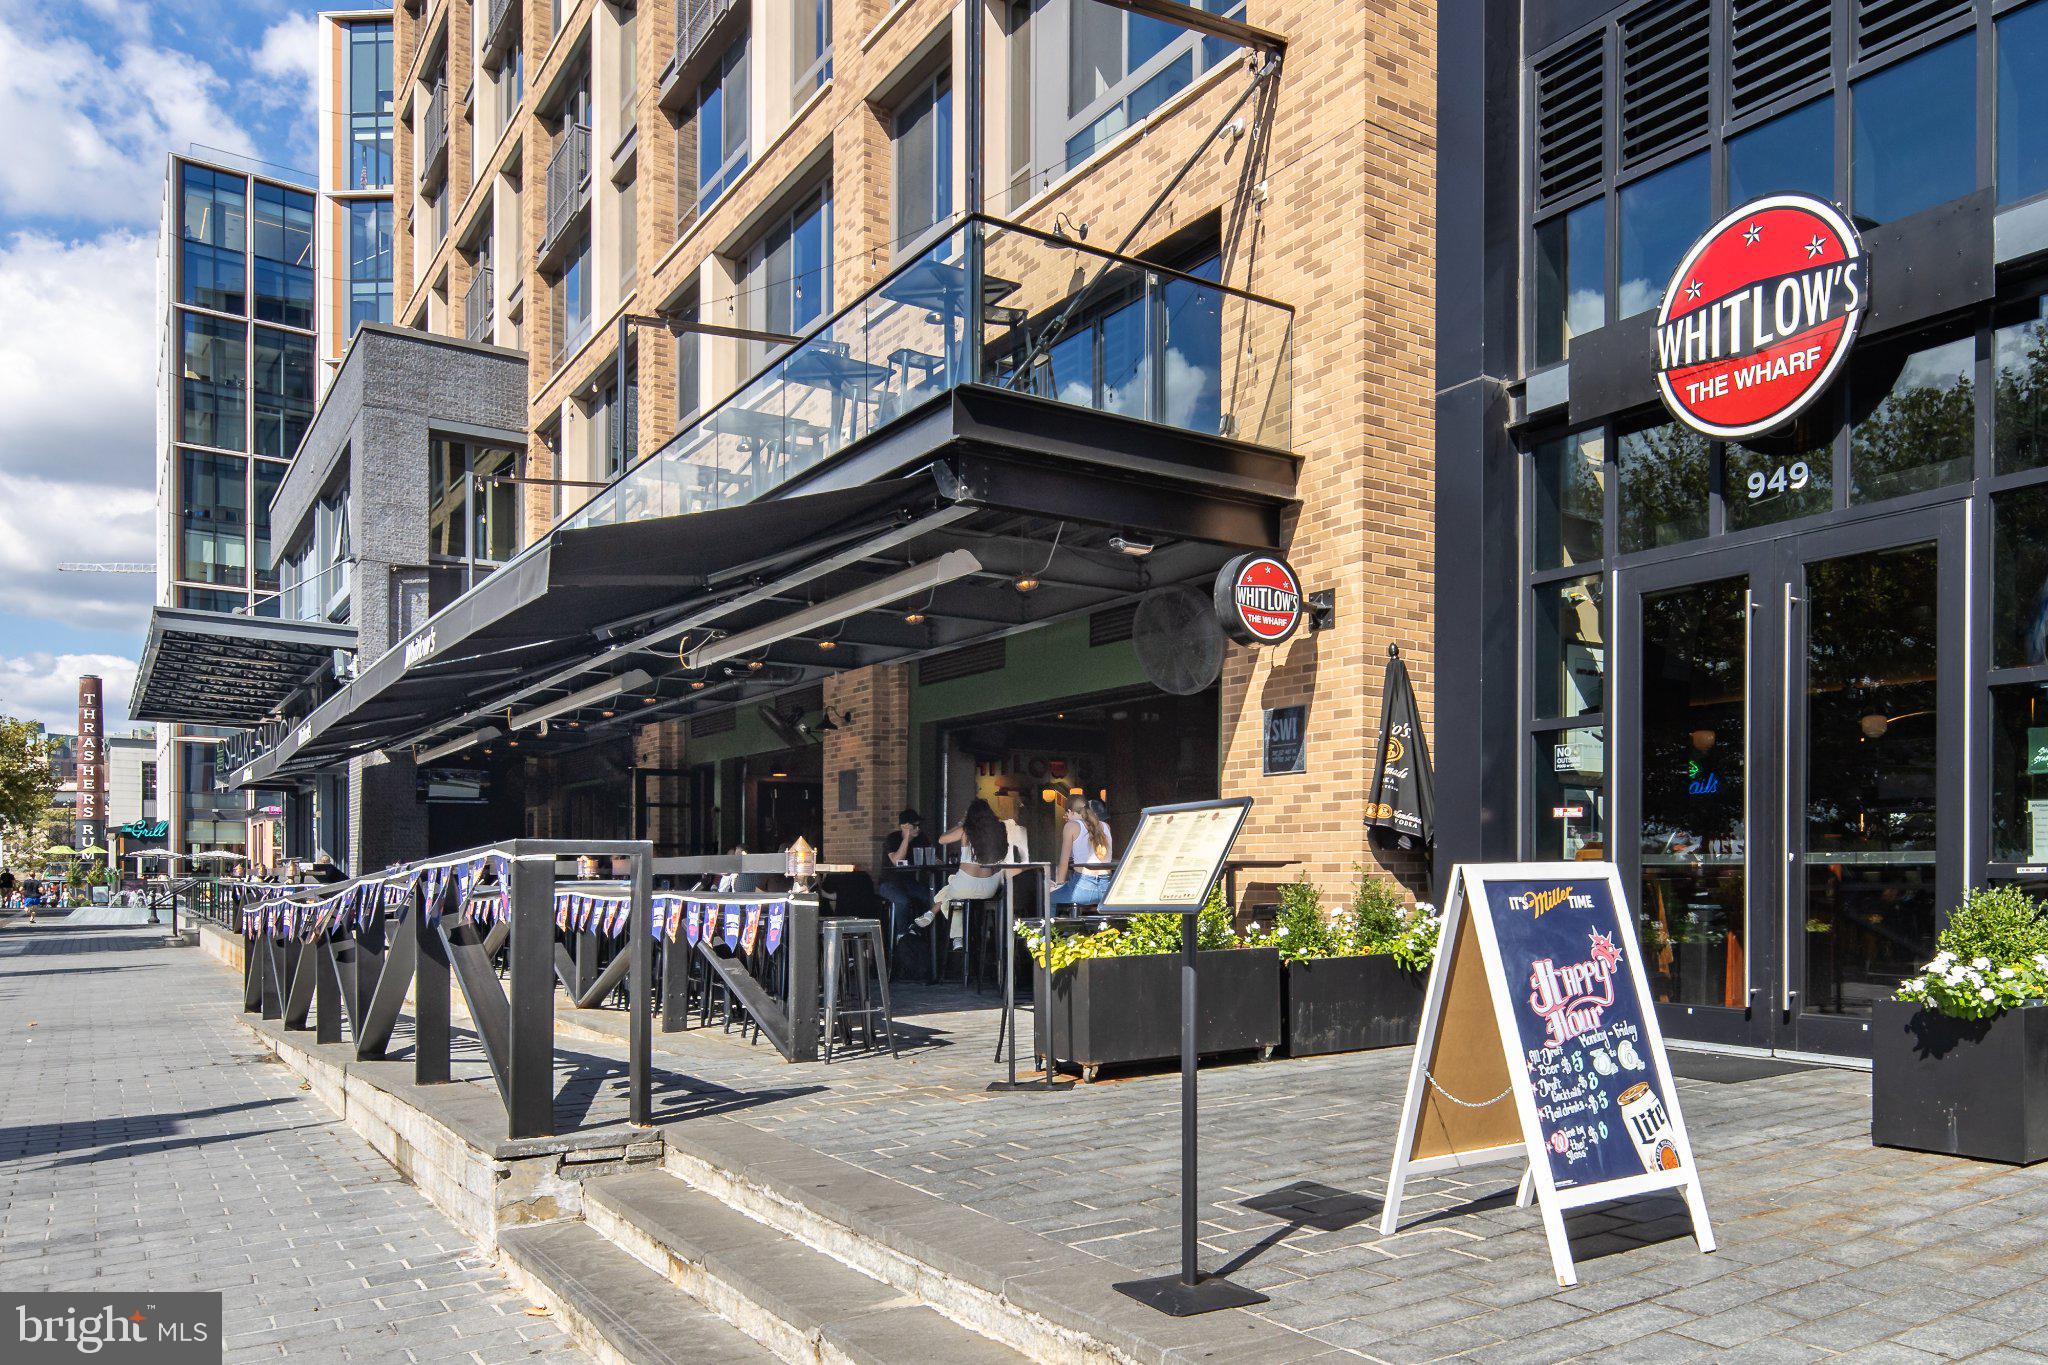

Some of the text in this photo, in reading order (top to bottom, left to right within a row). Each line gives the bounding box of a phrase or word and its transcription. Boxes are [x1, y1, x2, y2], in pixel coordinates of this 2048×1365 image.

[1657, 262, 1859, 370] WHITLOW'S
[1685, 345, 1823, 405] THE WHARF
[1747, 461, 1809, 499] 949
[1237, 586, 1298, 612] WHITLOW'S
[1247, 613, 1288, 627] THE WHARF
[83, 693, 96, 818] THRASHERS
[1557, 747, 1572, 757] NO
[131, 819, 169, 838] Grill
[1394, 818, 1418, 829] VODKA
[1509, 896, 1529, 910] IT'S
[1523, 886, 1573, 919] Miller
[1543, 1005, 1604, 1048] Hour
[1578, 1027, 1611, 1050] Monday
[1611, 1020, 1638, 1042] Friday
[1537, 1061, 1560, 1076] Beer
[1540, 1046, 1564, 1066] Draft
[1537, 1076, 1562, 1098] Draft
[1630, 1104, 1666, 1144] Lite
